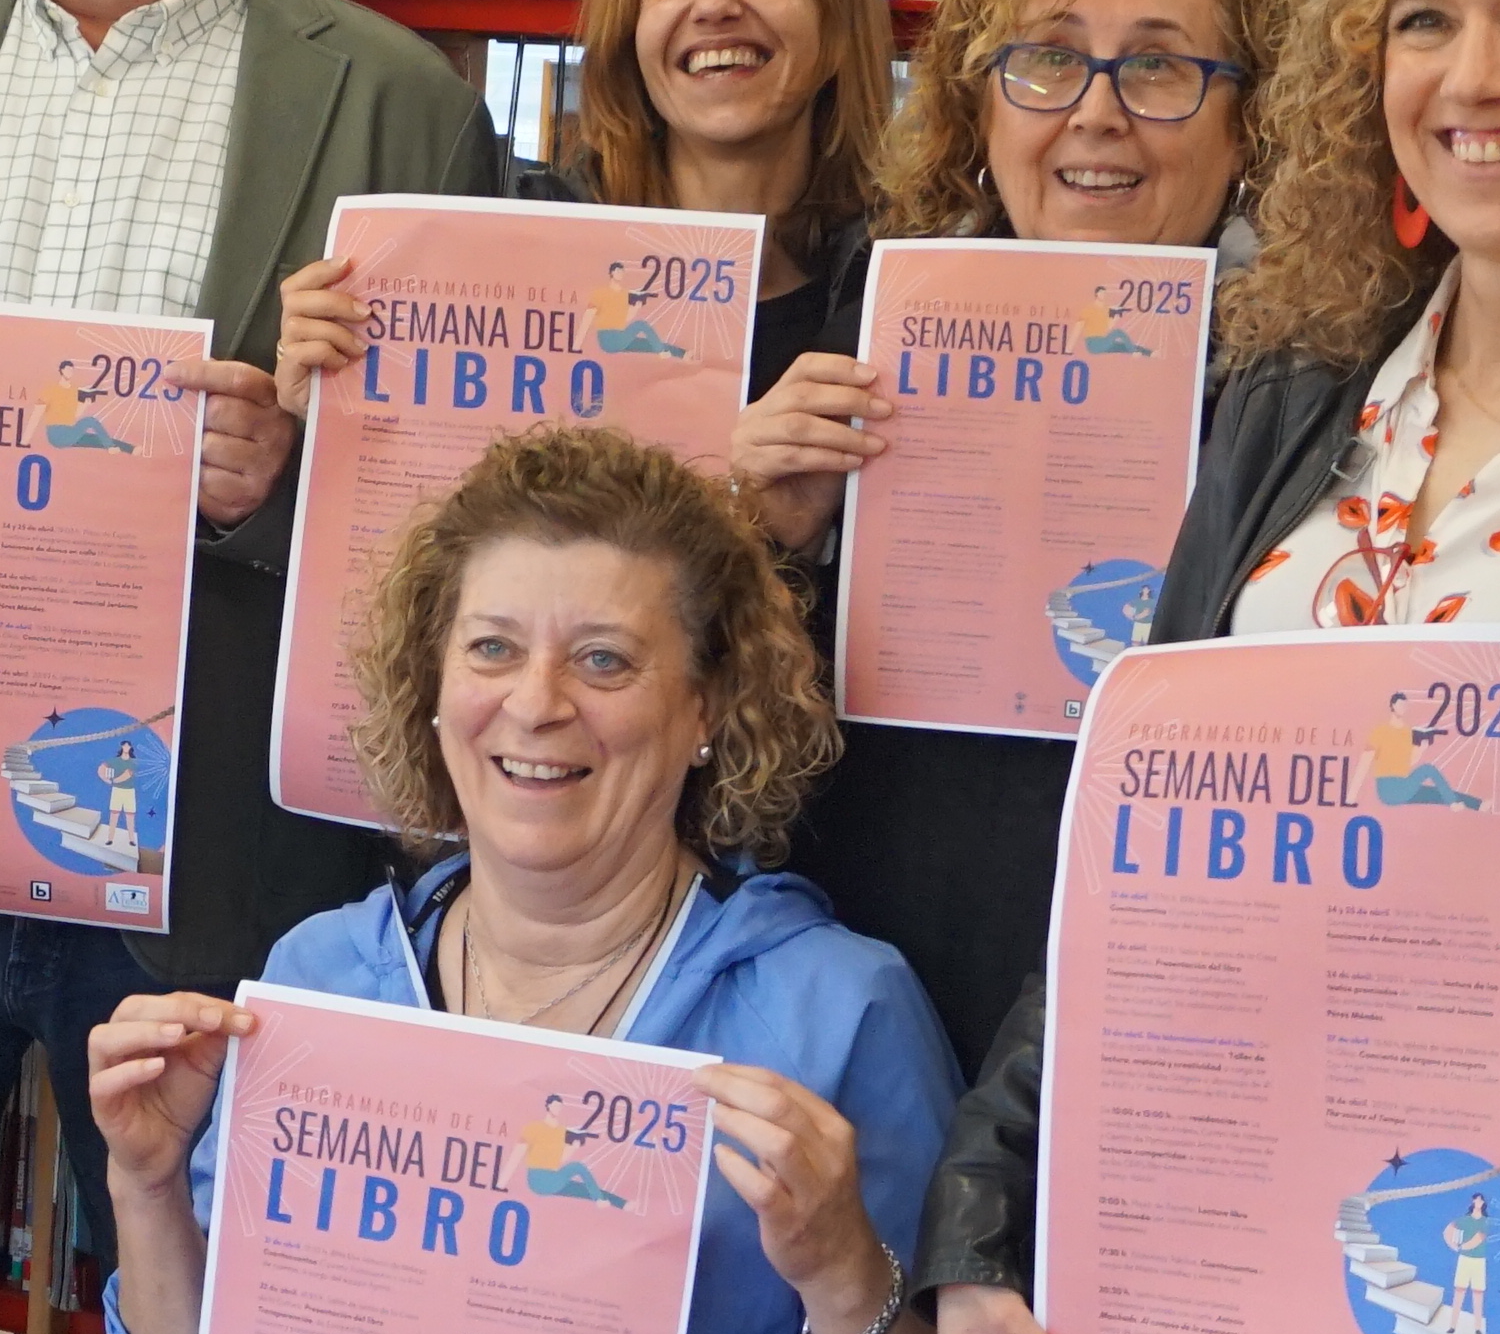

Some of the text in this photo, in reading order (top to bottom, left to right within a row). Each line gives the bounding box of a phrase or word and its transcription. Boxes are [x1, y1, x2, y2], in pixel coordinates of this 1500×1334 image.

[367, 276, 579, 306] PROGRAMACIÓN DE LA
[640, 253, 737, 305] 2025
[1118, 279, 1194, 316] 2025
[366, 298, 584, 355] SEMANA DEL
[901, 315, 1074, 356] SEMANA DEL
[8, 384, 29, 402] LA
[363, 345, 605, 419] LIBRO
[898, 350, 1091, 406] LIBRO
[1127, 721, 1355, 748] PROGRAMACIÓN DE LA
[1119, 748, 1360, 809] SEMANA DEL
[1111, 804, 1385, 891] LIBRO
[277, 1080, 509, 1138] PROGRAMACIÓN DE LA
[580, 1089, 689, 1154] 2025
[272, 1105, 510, 1194] SEMANA DEL
[265, 1157, 531, 1267] LIBRO
